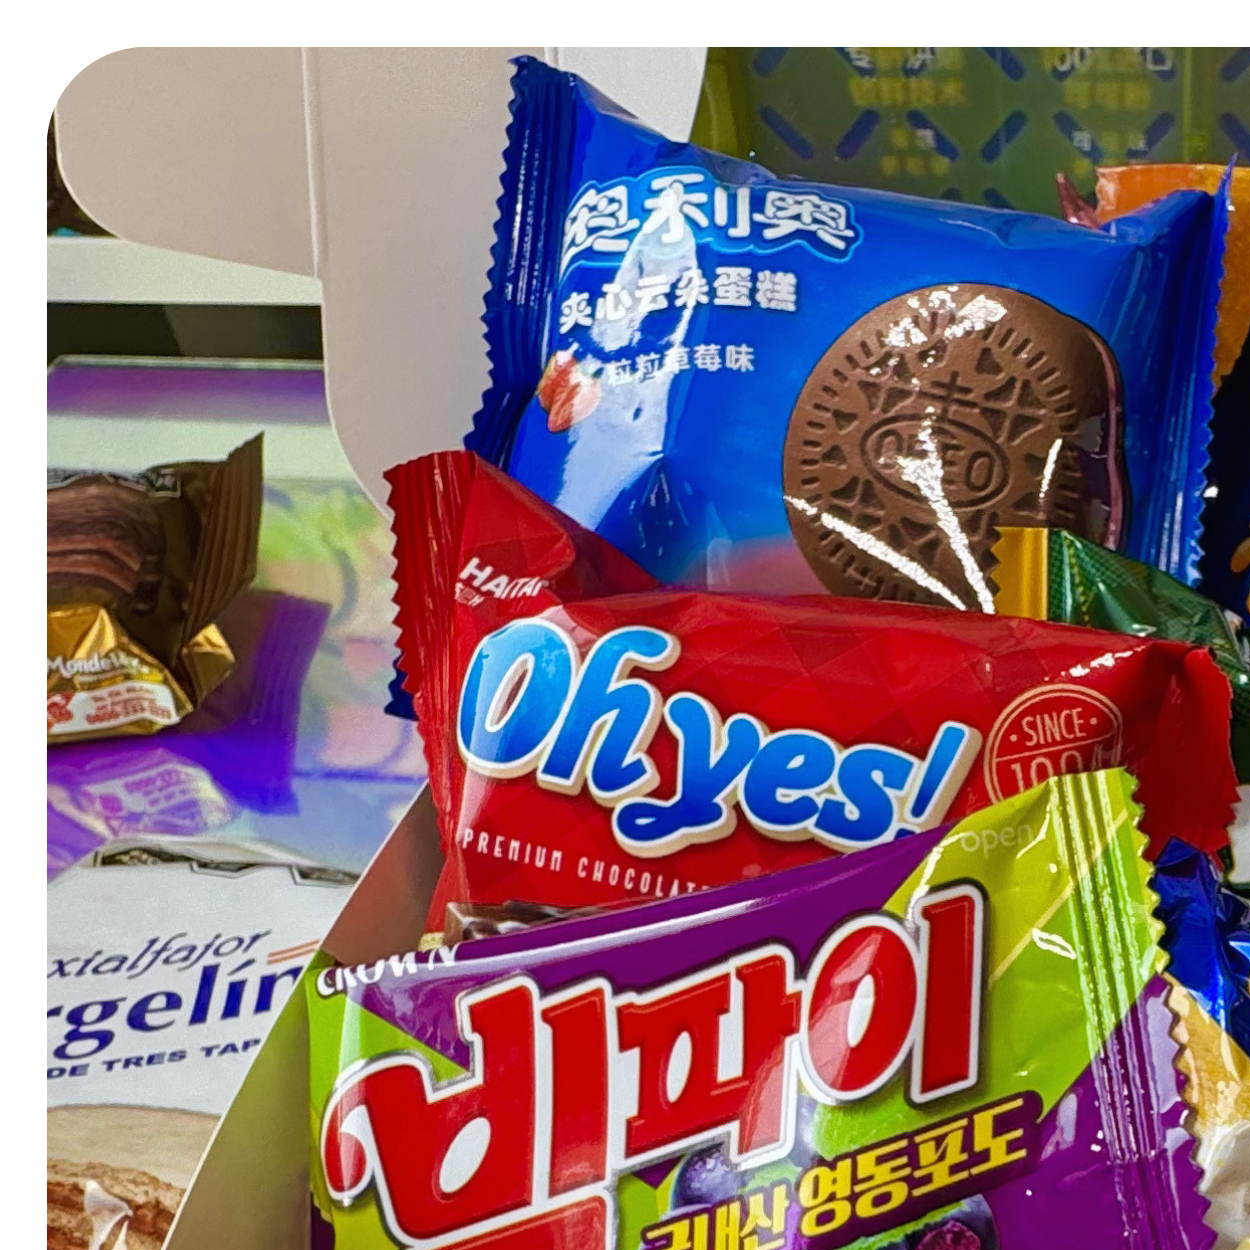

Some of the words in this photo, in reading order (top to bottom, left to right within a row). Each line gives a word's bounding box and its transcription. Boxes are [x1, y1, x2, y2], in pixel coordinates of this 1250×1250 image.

[562, 173, 855, 275] 奥利奥
[559, 266, 798, 334] 夹心云朵蛋糕
[604, 344, 756, 387] 粒粒草莓味
[457, 618, 681, 797] Oh
[614, 690, 983, 855] yes!
[1021, 707, 1087, 746] SINCE
[462, 828, 563, 872] PREMIUM
[959, 823, 1035, 860] open
[101, 1049, 188, 1073] TRES
[798, 1098, 1028, 1235] 영동포도
